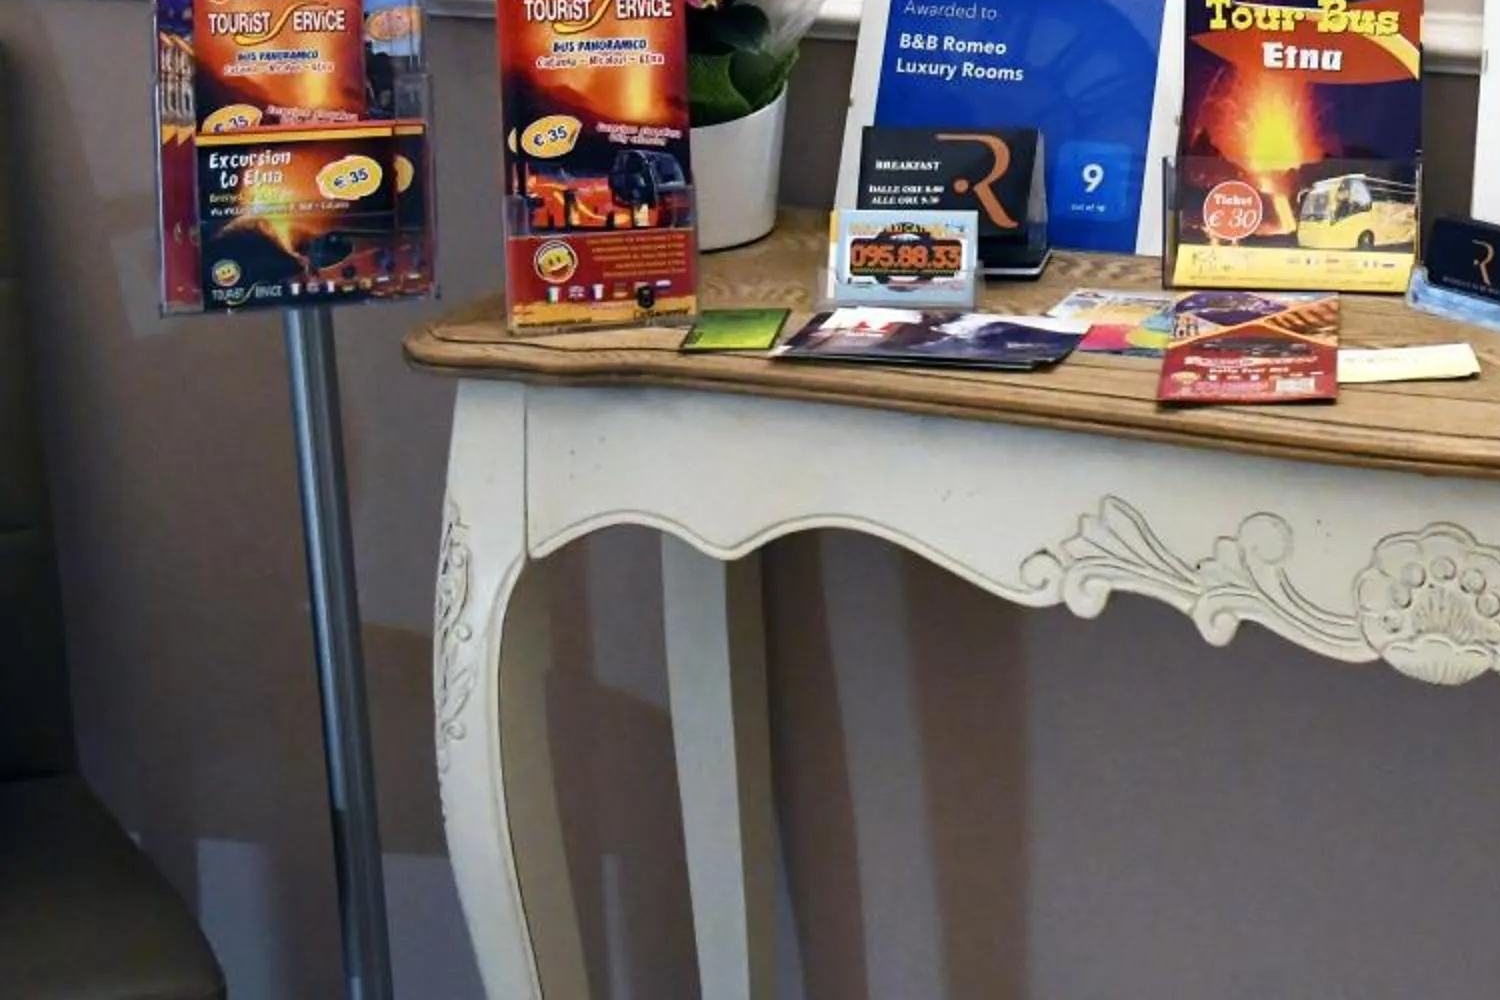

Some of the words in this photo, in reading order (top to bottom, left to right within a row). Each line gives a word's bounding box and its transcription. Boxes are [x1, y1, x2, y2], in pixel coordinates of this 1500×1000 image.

[903, 0, 977, 19] Awarded
[981, 7, 997, 20] to
[899, 32, 938, 51] B&B
[943, 35, 1007, 55] Romeo
[1262, 41, 1342, 71] Etna
[896, 57, 957, 81] Luxury
[961, 61, 1024, 81] Rooms
[209, 150, 292, 169] Excursion
[349, 167, 369, 183] 35
[1083, 163, 1104, 193] 9
